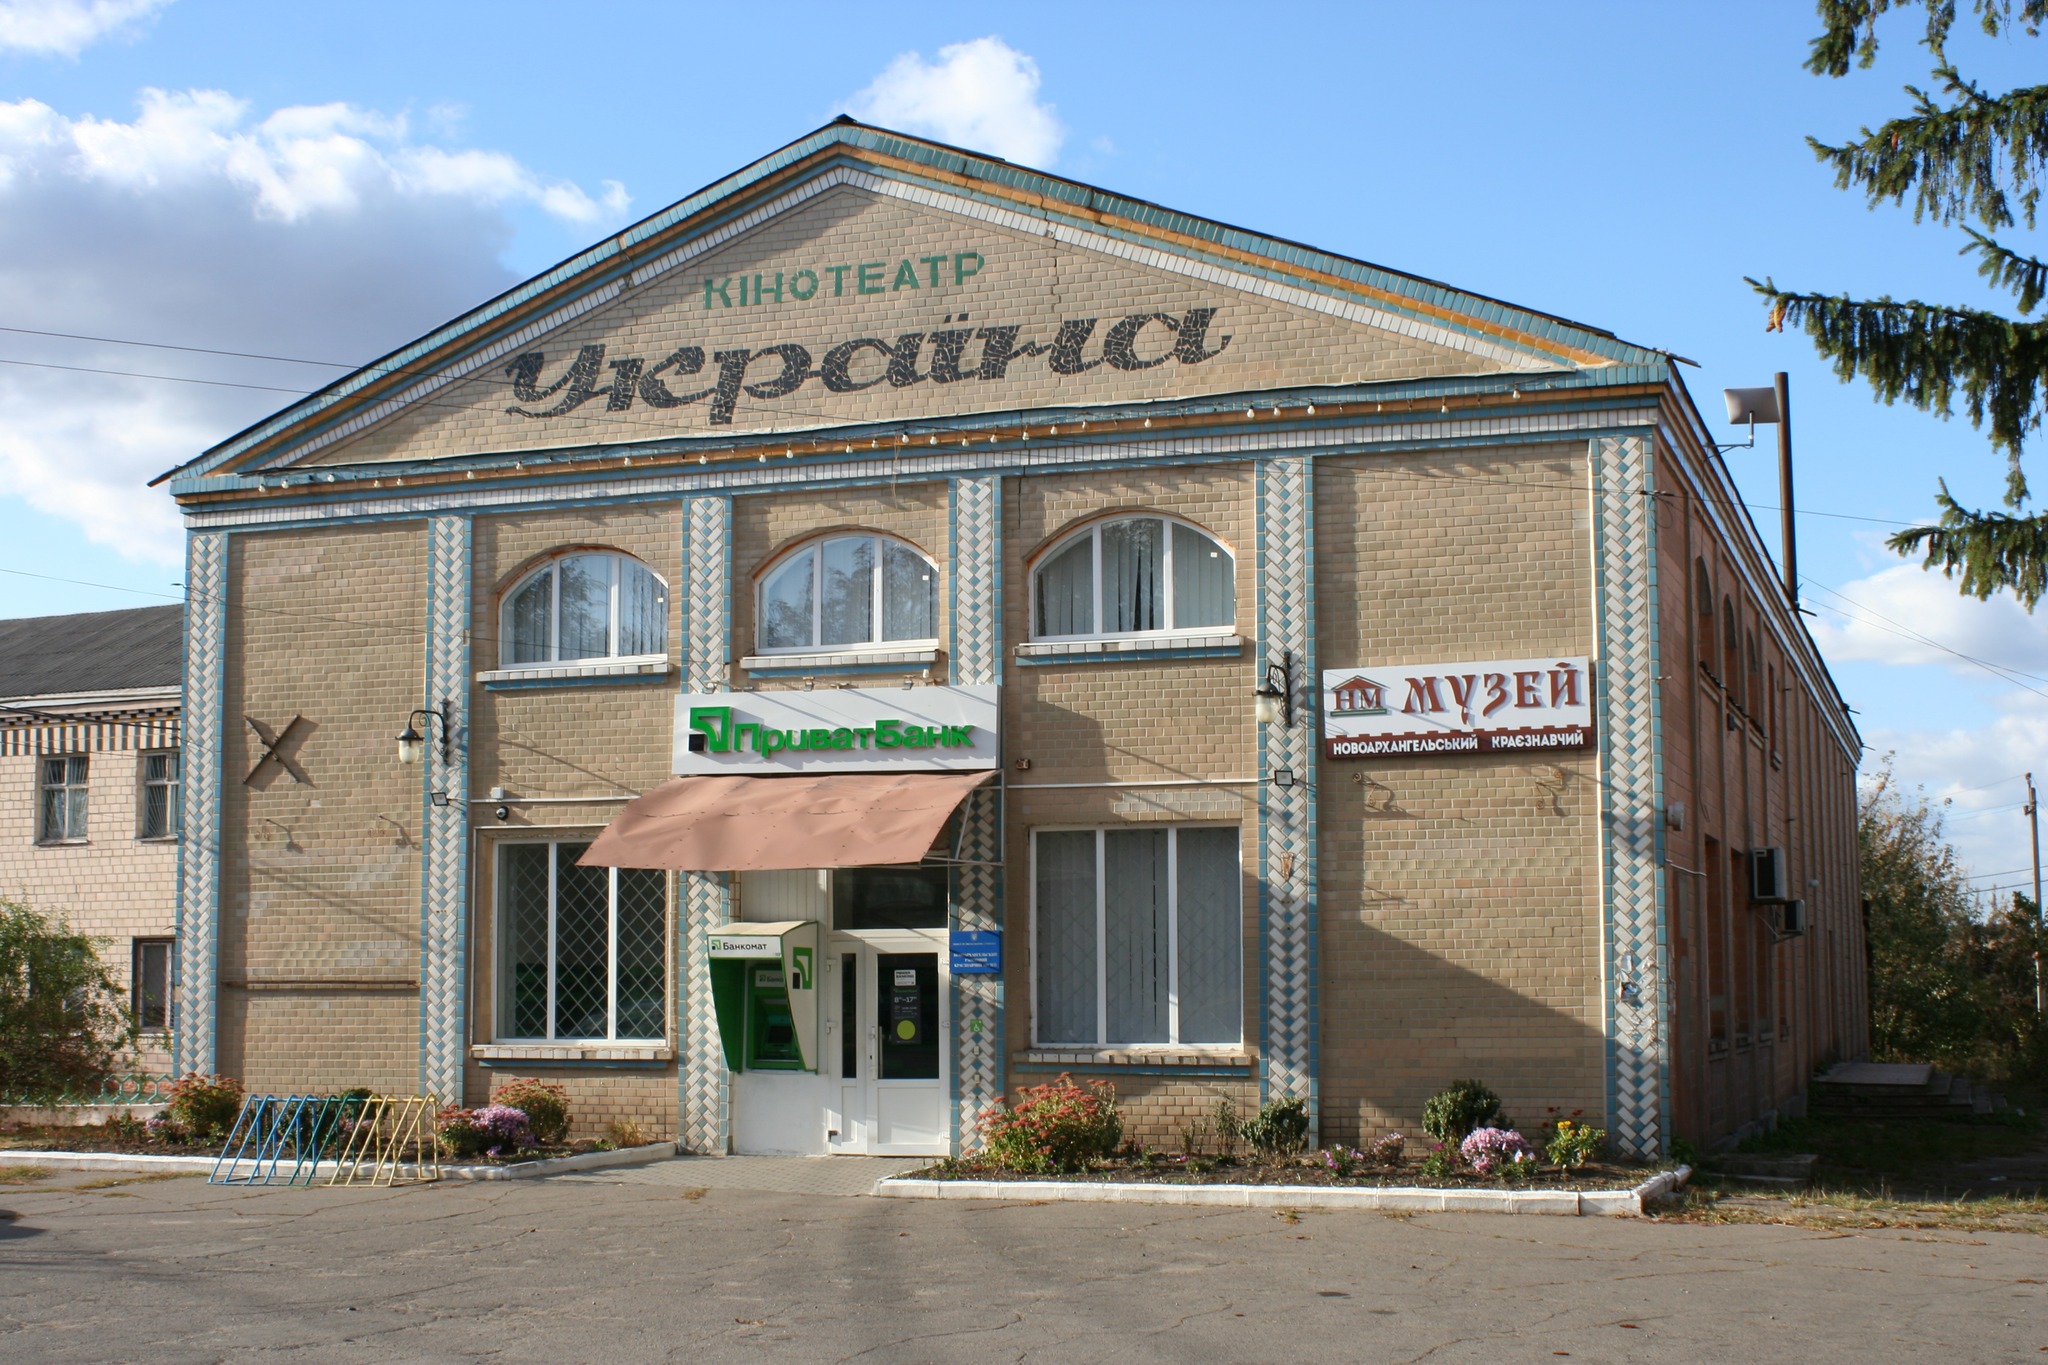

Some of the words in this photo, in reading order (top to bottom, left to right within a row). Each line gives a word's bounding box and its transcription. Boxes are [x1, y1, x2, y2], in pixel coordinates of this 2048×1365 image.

[704, 252, 985, 309] КІНОТЕАТР
[1401, 662, 1580, 725] МУЗЕЙ
[733, 719, 975, 758] ПриватБанк
[1333, 734, 1479, 756] НОВОАРХАНГЕЛЬСЬКИЙ
[1491, 730, 1584, 749] КРАЄЗНАВЧИЙ
[722, 941, 768, 951] Банкомат
